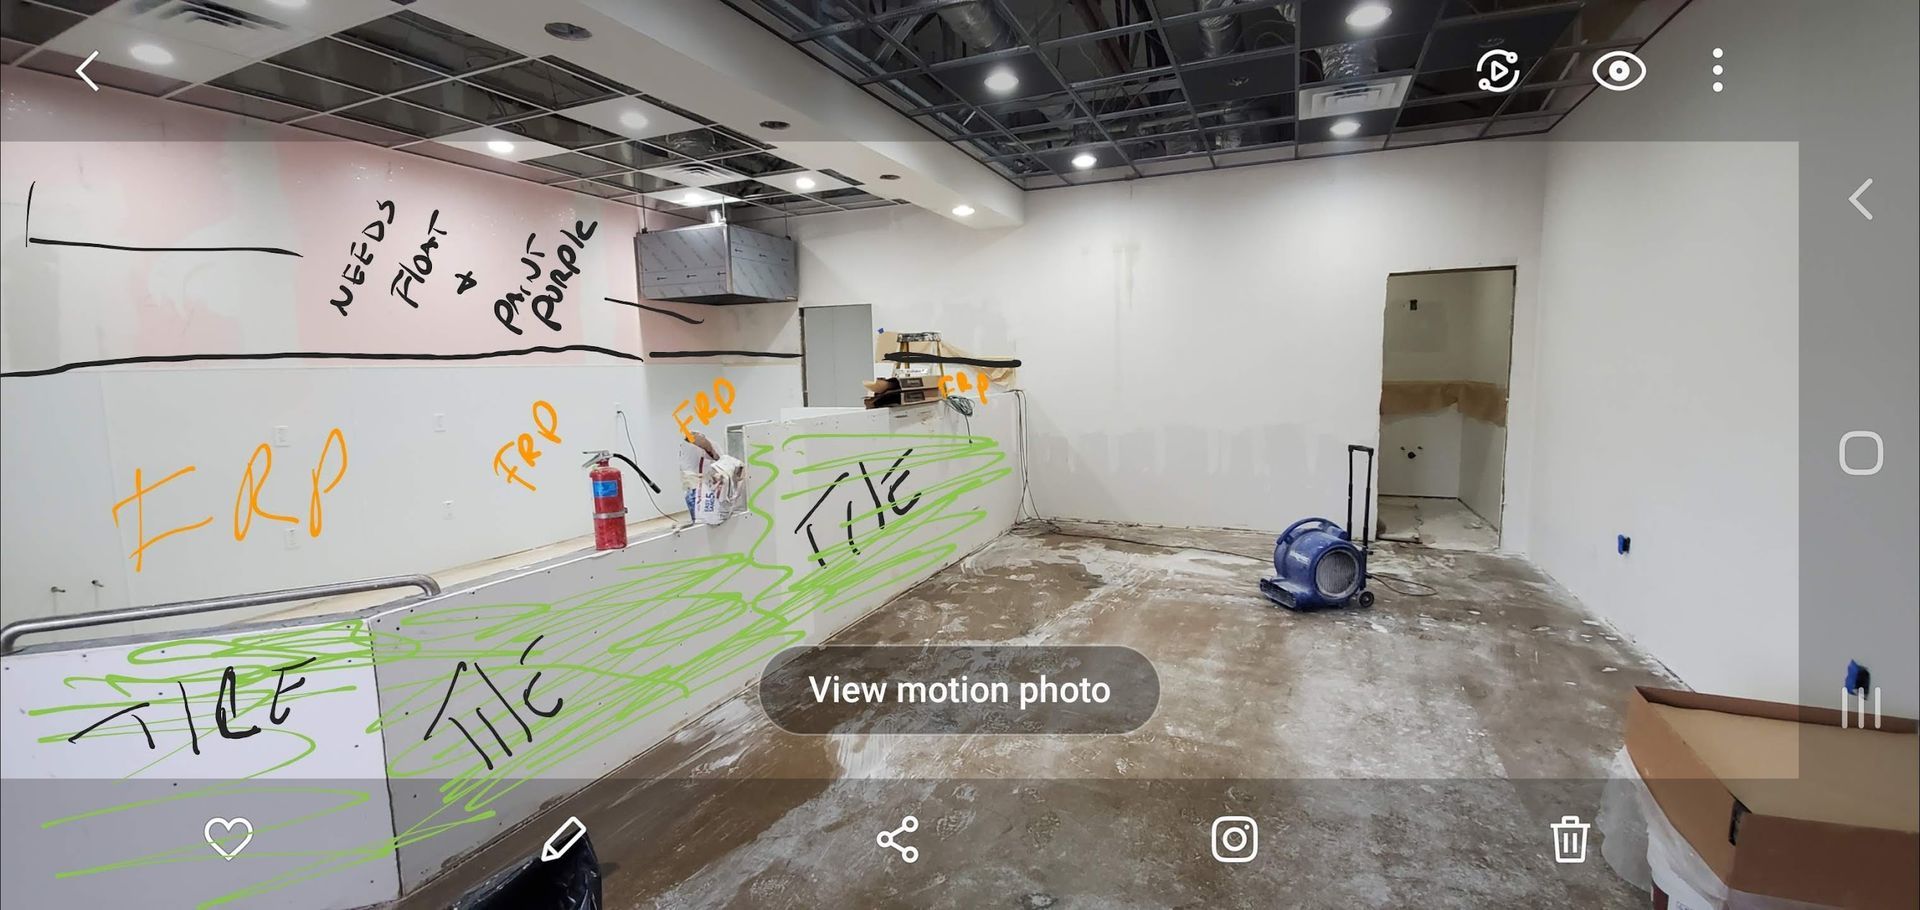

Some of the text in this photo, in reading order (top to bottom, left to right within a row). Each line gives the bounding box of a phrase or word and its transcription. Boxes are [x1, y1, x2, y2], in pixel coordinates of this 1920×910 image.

[330, 199, 396, 317] NEEDS
[671, 377, 736, 443] FRP
[937, 371, 990, 406] FRP
[493, 400, 561, 491] FRP
[112, 428, 348, 572] FRP
